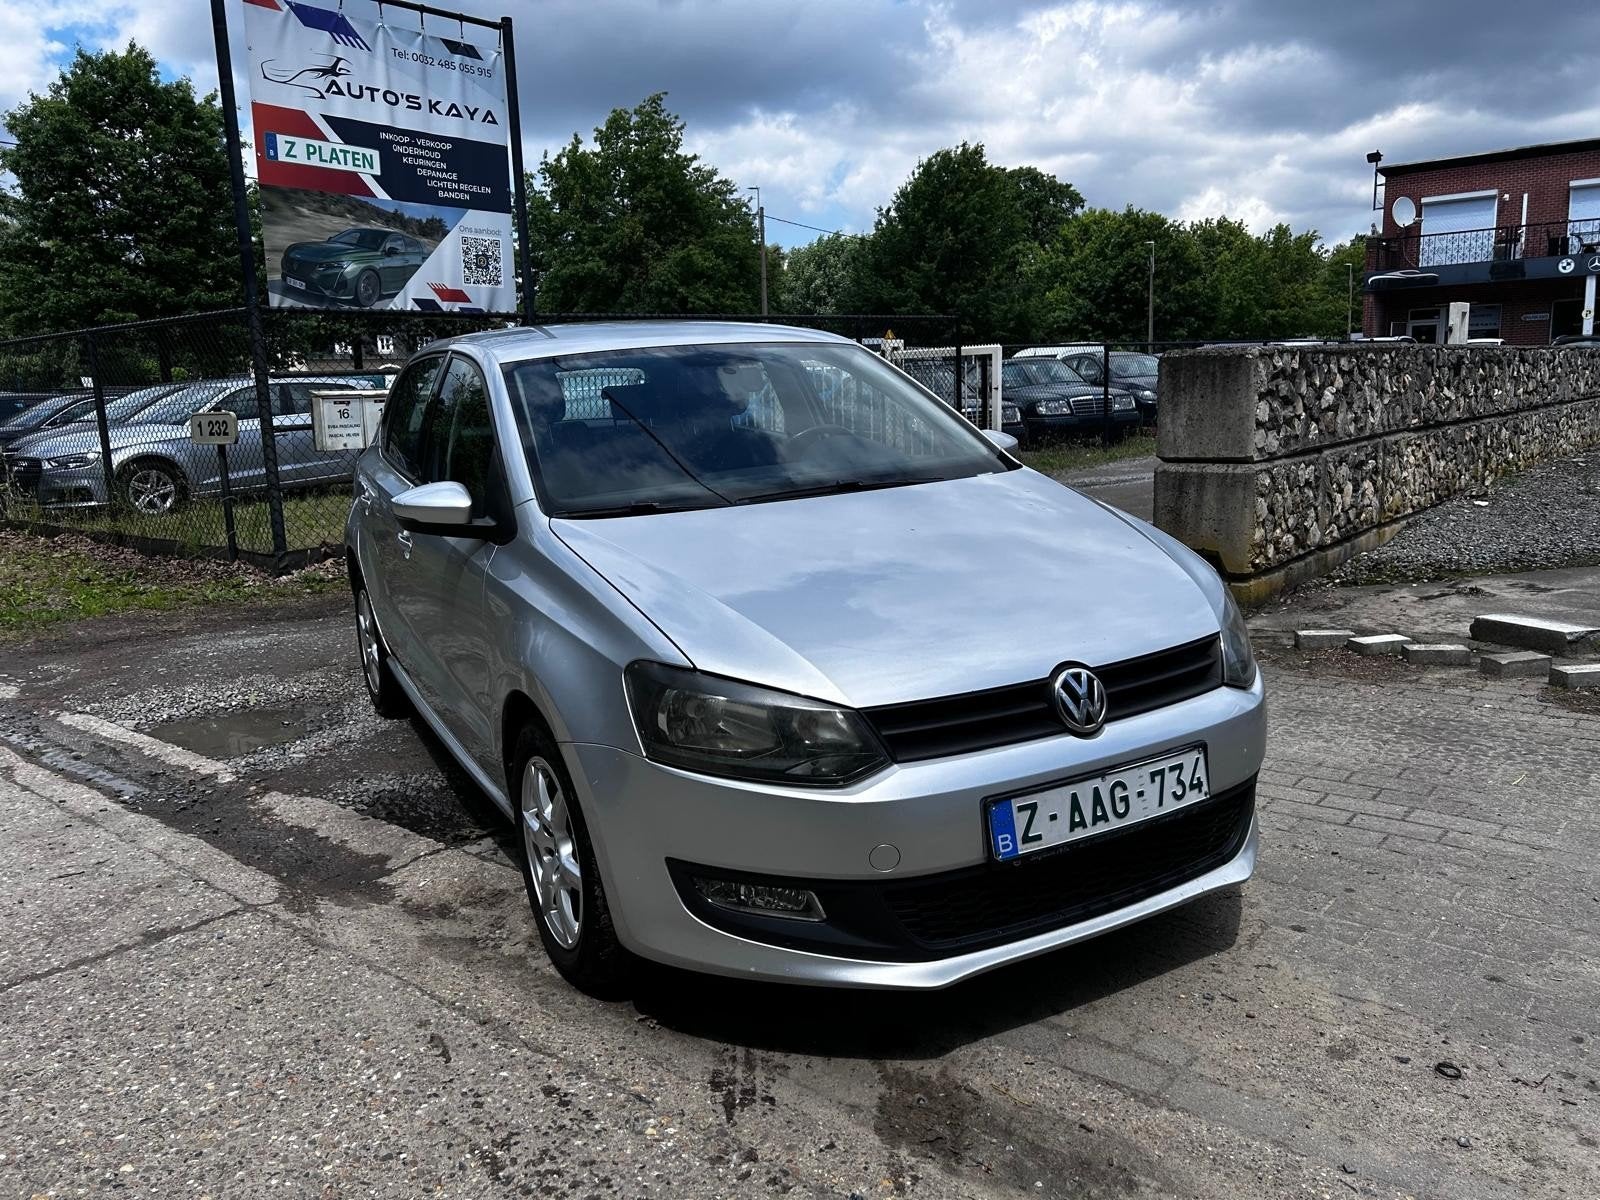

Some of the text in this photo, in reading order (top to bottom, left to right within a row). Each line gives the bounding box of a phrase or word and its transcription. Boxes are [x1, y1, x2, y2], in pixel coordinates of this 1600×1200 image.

[391, 47, 492, 78] Tel: 0032 485 055 915
[325, 79, 498, 125] AUTO'S KAYA
[380, 132, 410, 143] INKOOP
[416, 138, 453, 150] VERKOOP
[284, 140, 374, 169] Z PLATEN
[392, 144, 441, 159] ONDERHOUD
[402, 156, 447, 169] KEURINGEN
[417, 168, 458, 180] DEPANAGE
[427, 179, 491, 194] LICHTEN REGELEN
[438, 190, 470, 200] BANDEN
[337, 408, 350, 419] 16
[197, 420, 229, 437] 1 232
[997, 834, 1013, 853] B
